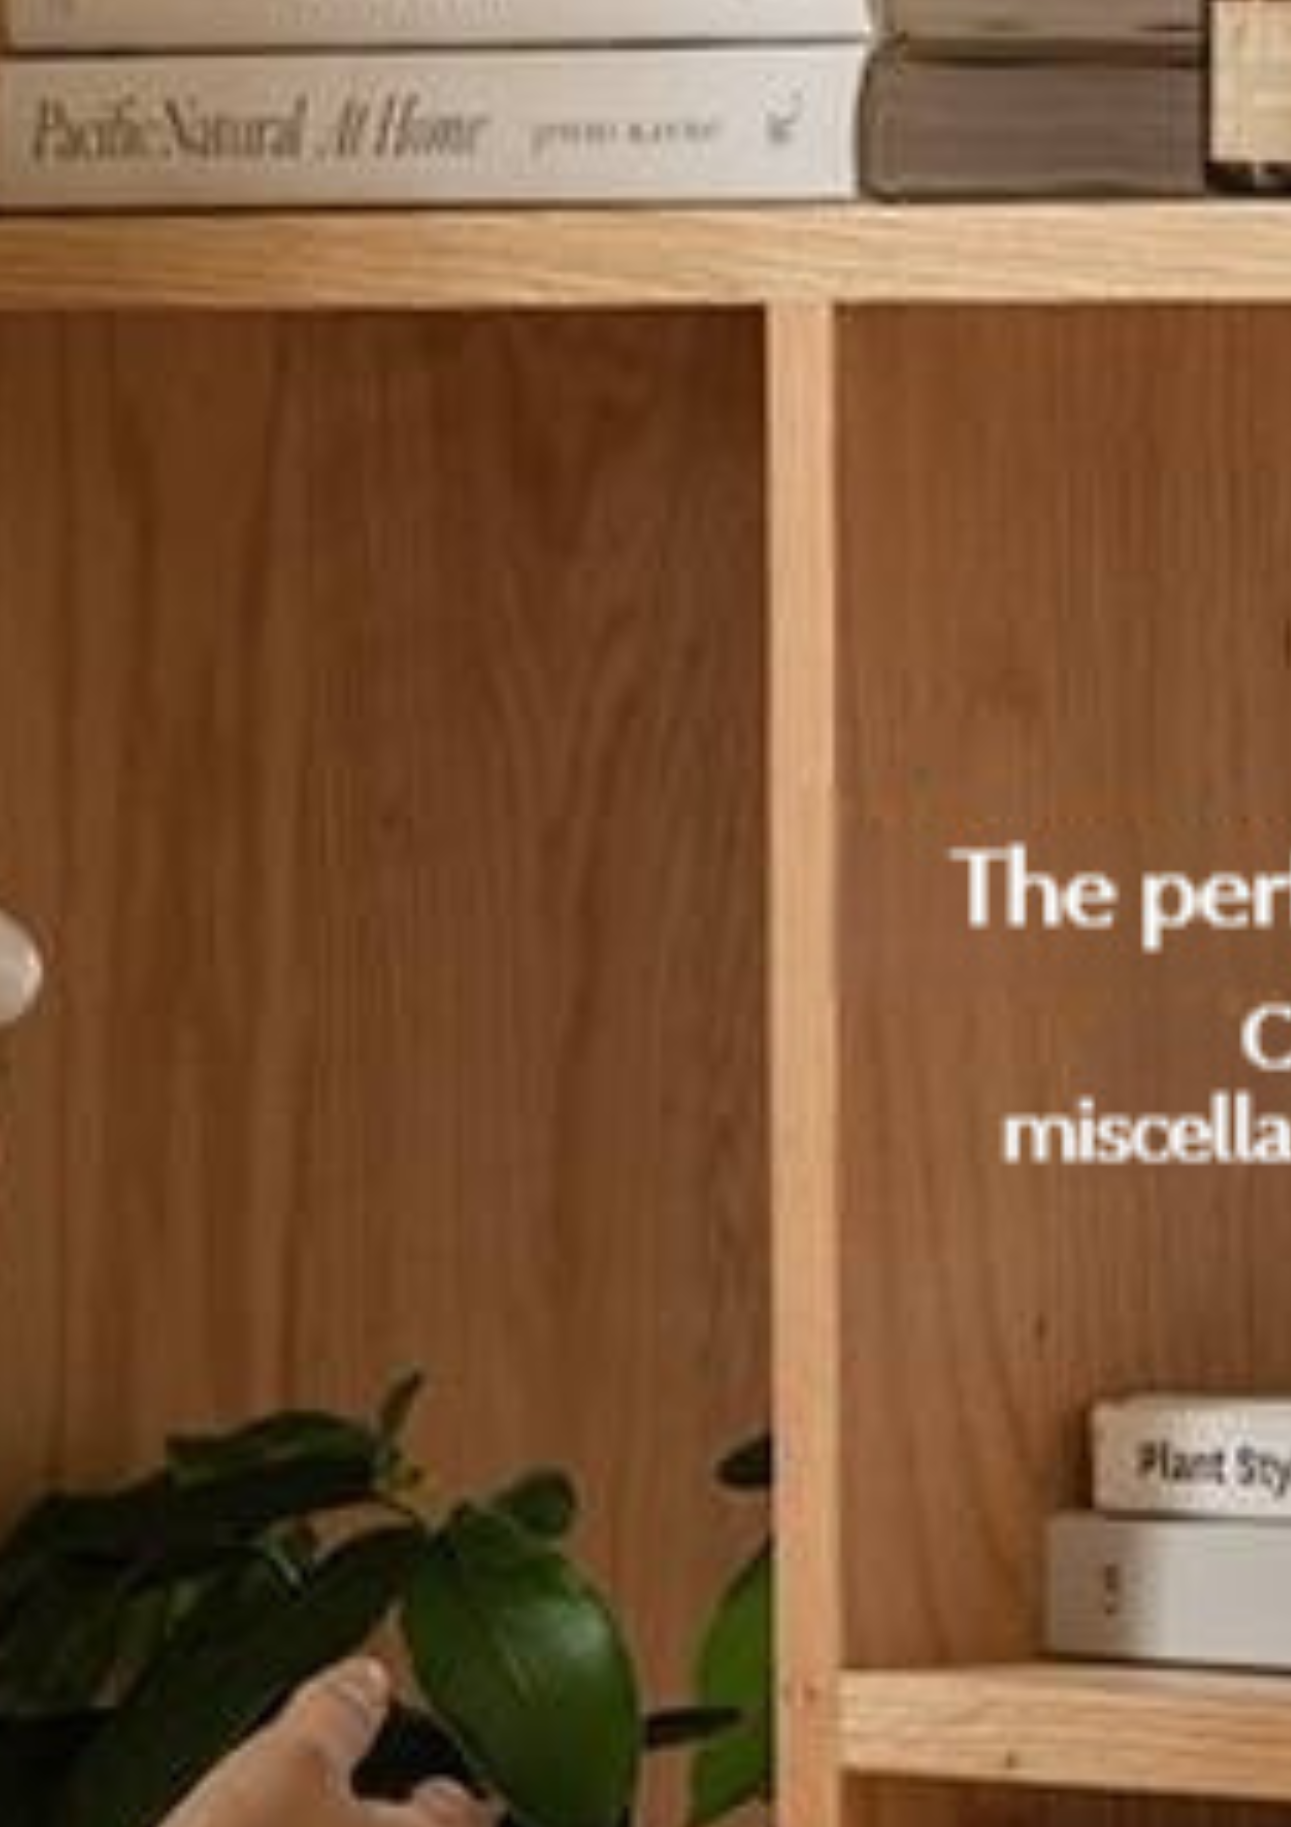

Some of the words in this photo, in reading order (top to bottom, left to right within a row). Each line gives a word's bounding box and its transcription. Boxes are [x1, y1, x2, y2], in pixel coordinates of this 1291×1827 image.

[162, 93, 307, 159] Natural
[372, 91, 491, 159] Home
[1136, 1439, 1227, 1486] Plant
